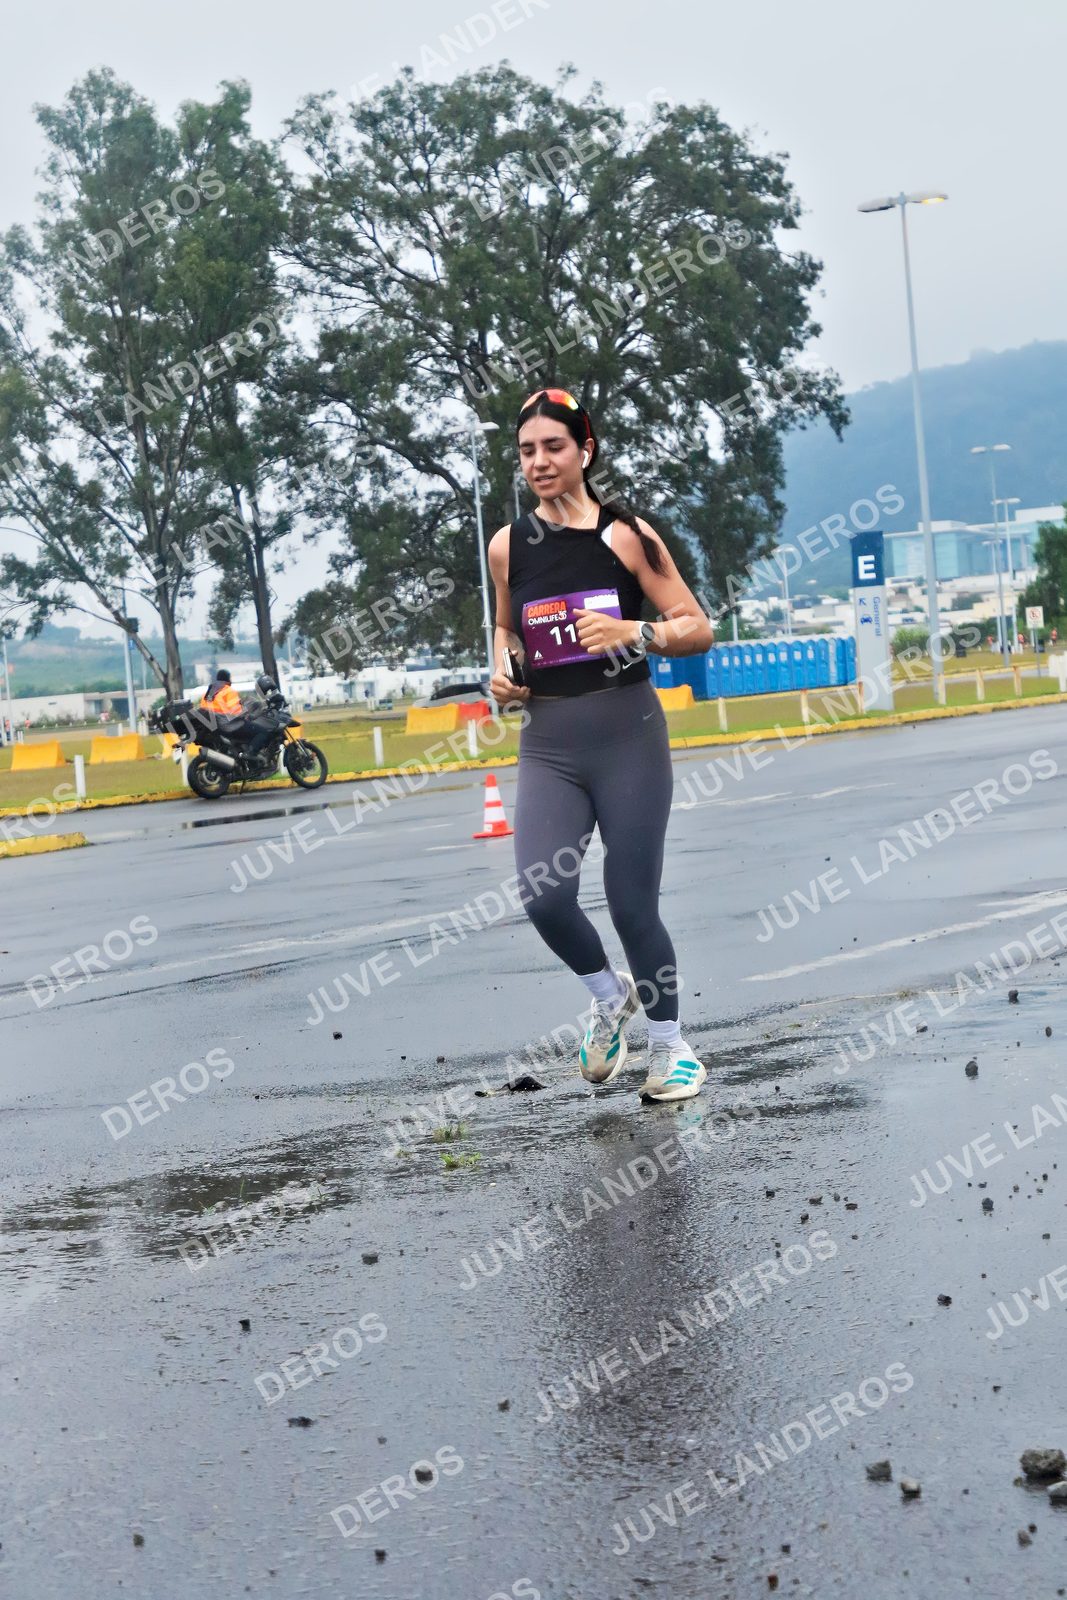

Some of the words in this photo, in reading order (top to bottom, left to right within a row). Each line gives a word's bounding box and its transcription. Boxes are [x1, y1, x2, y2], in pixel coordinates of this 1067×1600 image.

[858, 555, 876, 580] E
[528, 600, 567, 618] CARRERA
[873, 596, 882, 637] General
[549, 623, 577, 645] 11
